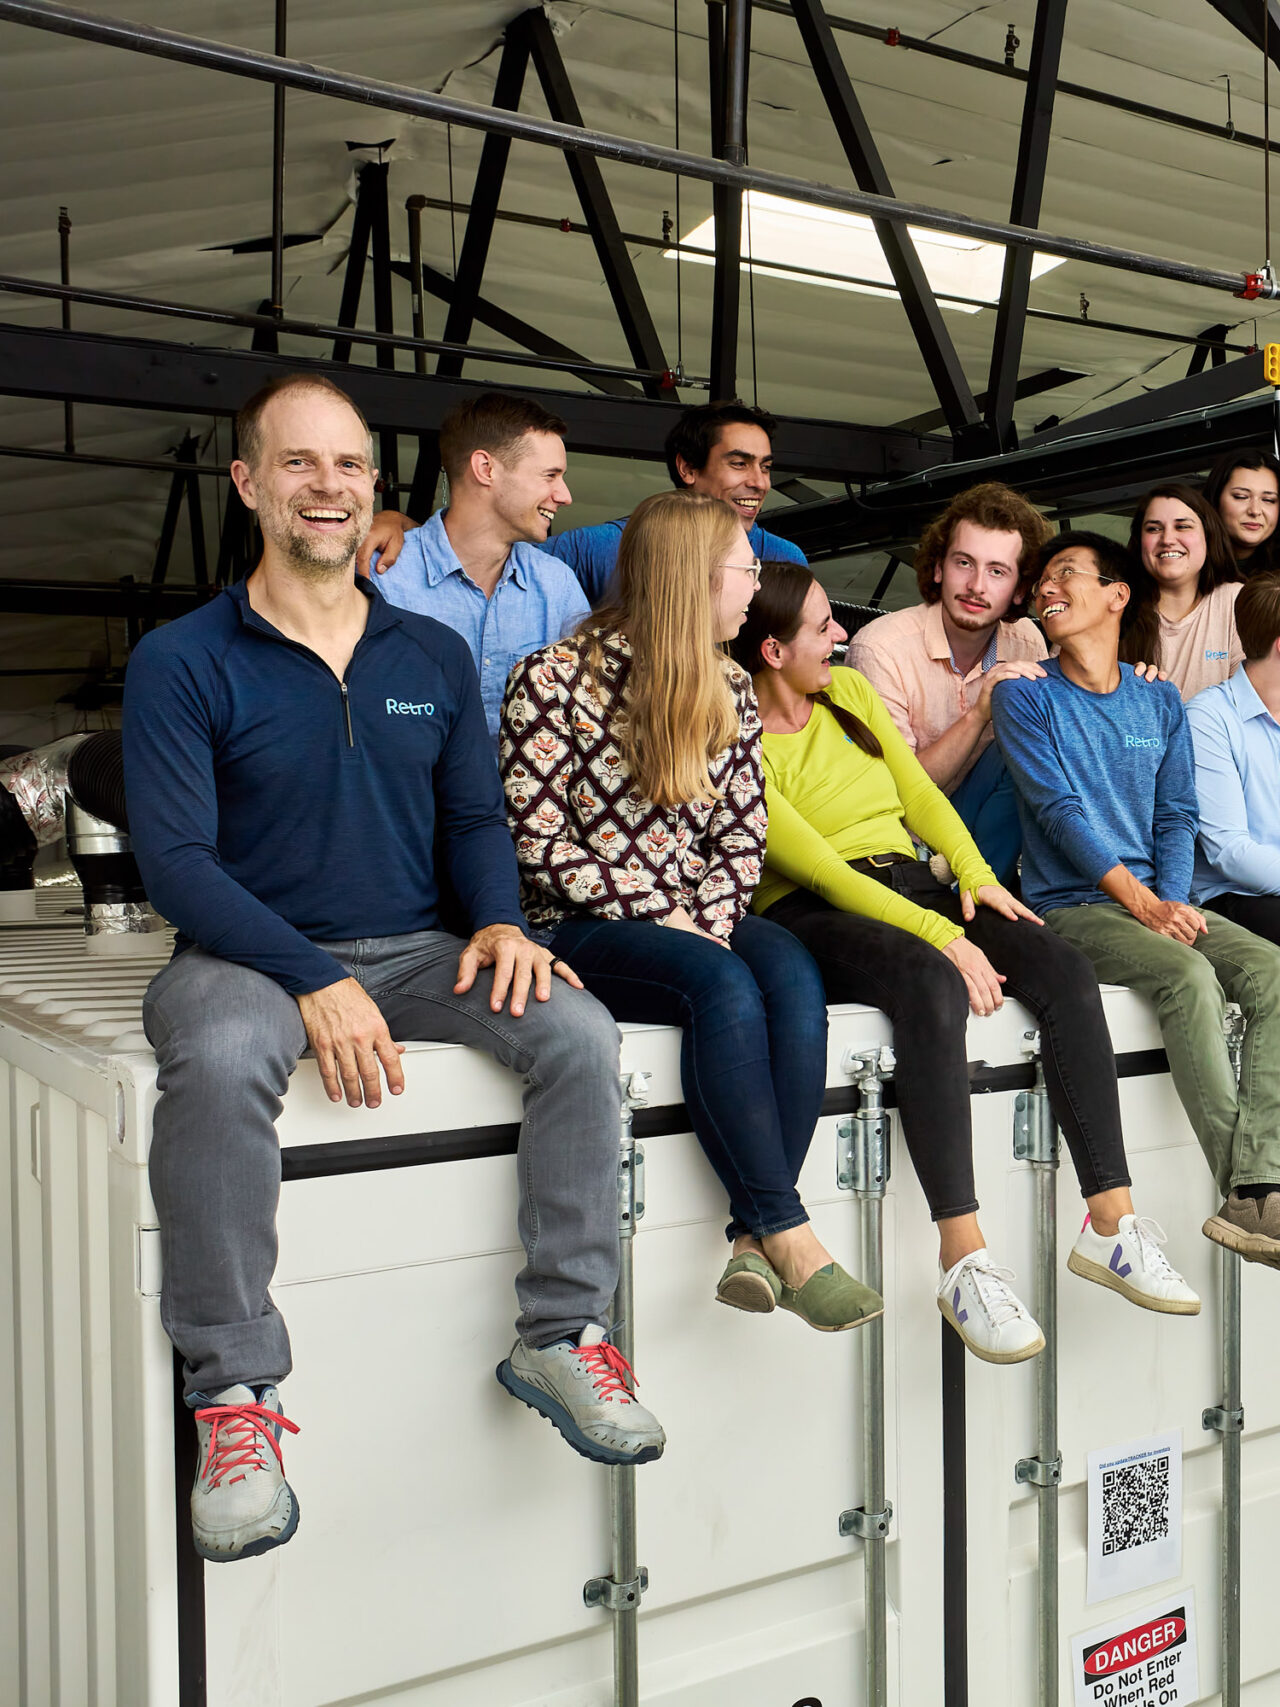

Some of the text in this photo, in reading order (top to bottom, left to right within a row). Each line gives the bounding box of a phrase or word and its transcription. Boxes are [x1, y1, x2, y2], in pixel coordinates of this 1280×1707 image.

[385, 698, 435, 715] Retro
[1125, 734, 1160, 748] Retro
[1095, 1621, 1176, 1672] DANGER
[1093, 1651, 1182, 1700] Do Not Enter
[1104, 1669, 1175, 1707] When Red
[1158, 1688, 1178, 1706] On
